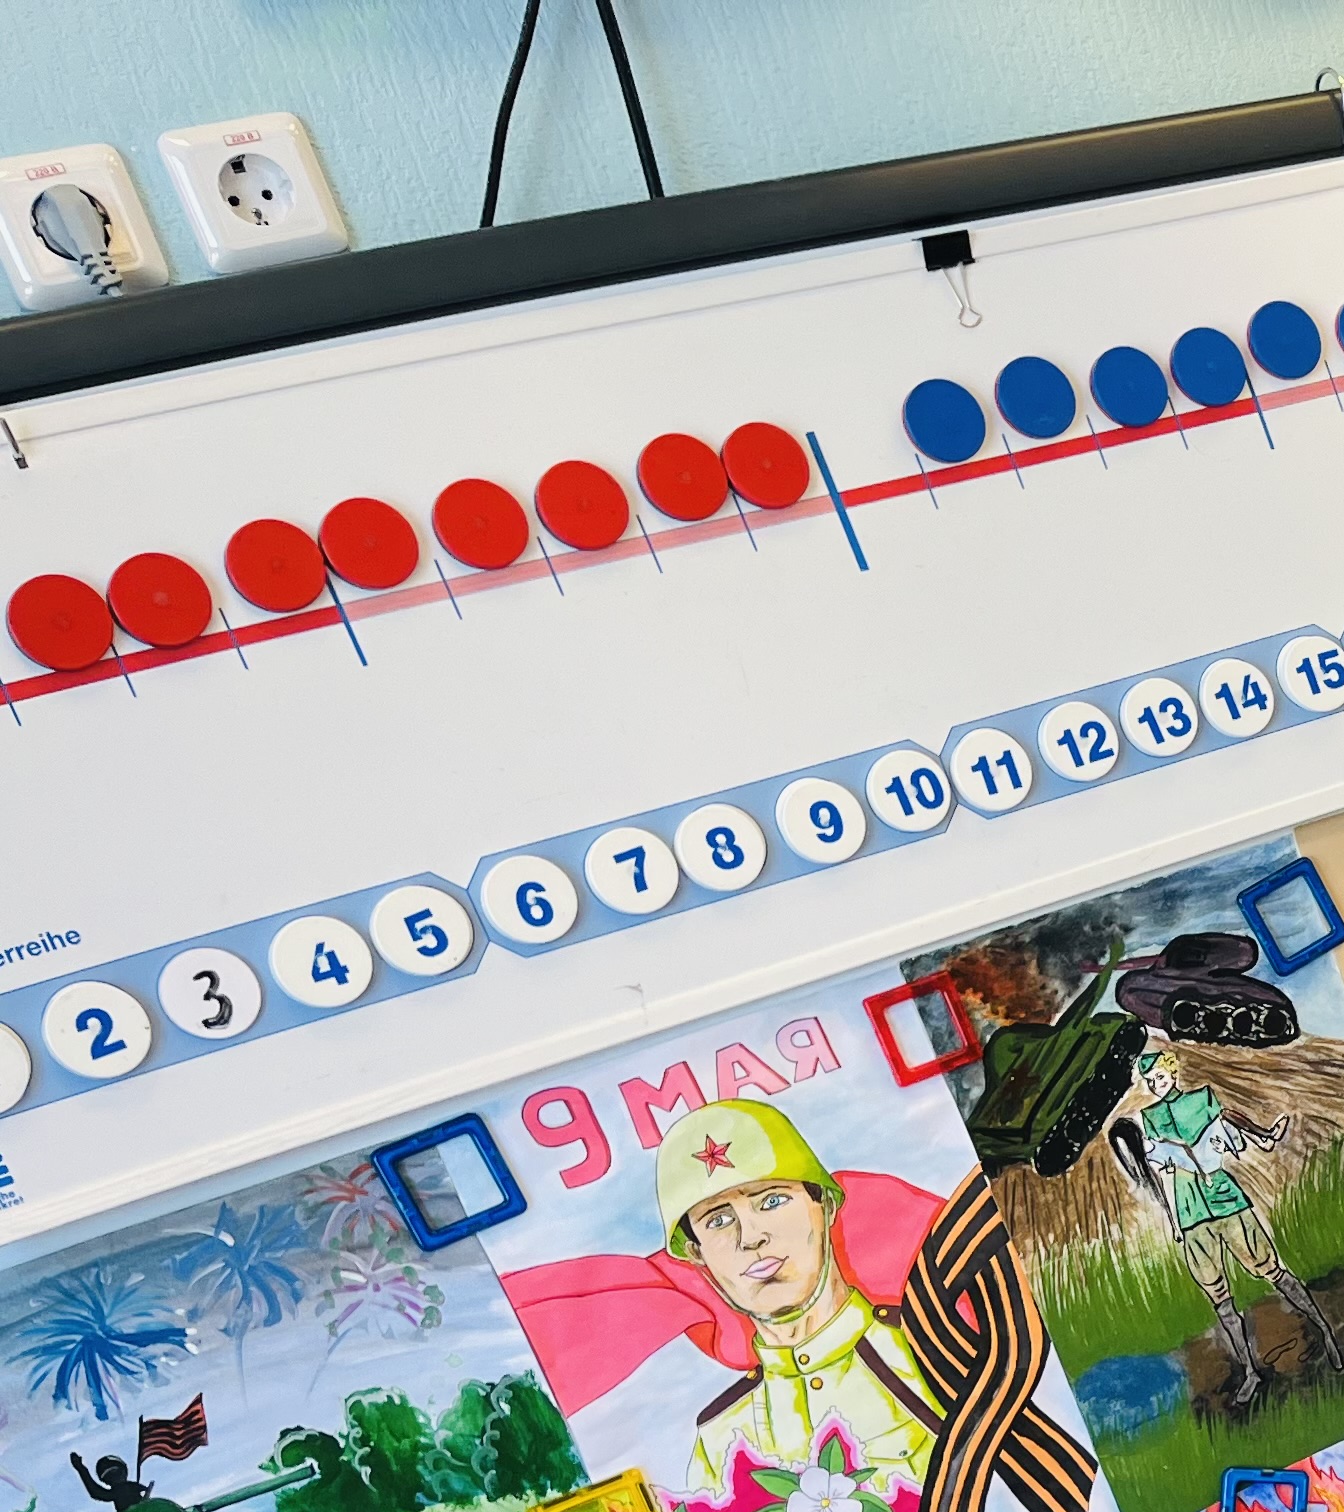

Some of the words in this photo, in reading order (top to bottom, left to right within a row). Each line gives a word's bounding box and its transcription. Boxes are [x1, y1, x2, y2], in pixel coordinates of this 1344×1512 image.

[76, 1009, 126, 1059] 2
[194, 971, 232, 1028] 3
[312, 944, 348, 984] 4
[405, 909, 448, 956] 5
[516, 882, 553, 926] 6
[614, 847, 647, 892] 7
[706, 828, 744, 869] 8
[810, 801, 843, 842] 9
[886, 768, 943, 815] 10
[972, 751, 1021, 794] 11
[1058, 722, 1114, 767] 12
[1139, 698, 1191, 744] 13
[1216, 676, 1267, 719] 14
[521, 1086, 612, 1189] 9
[618, 1016, 842, 1150] МАЯ
